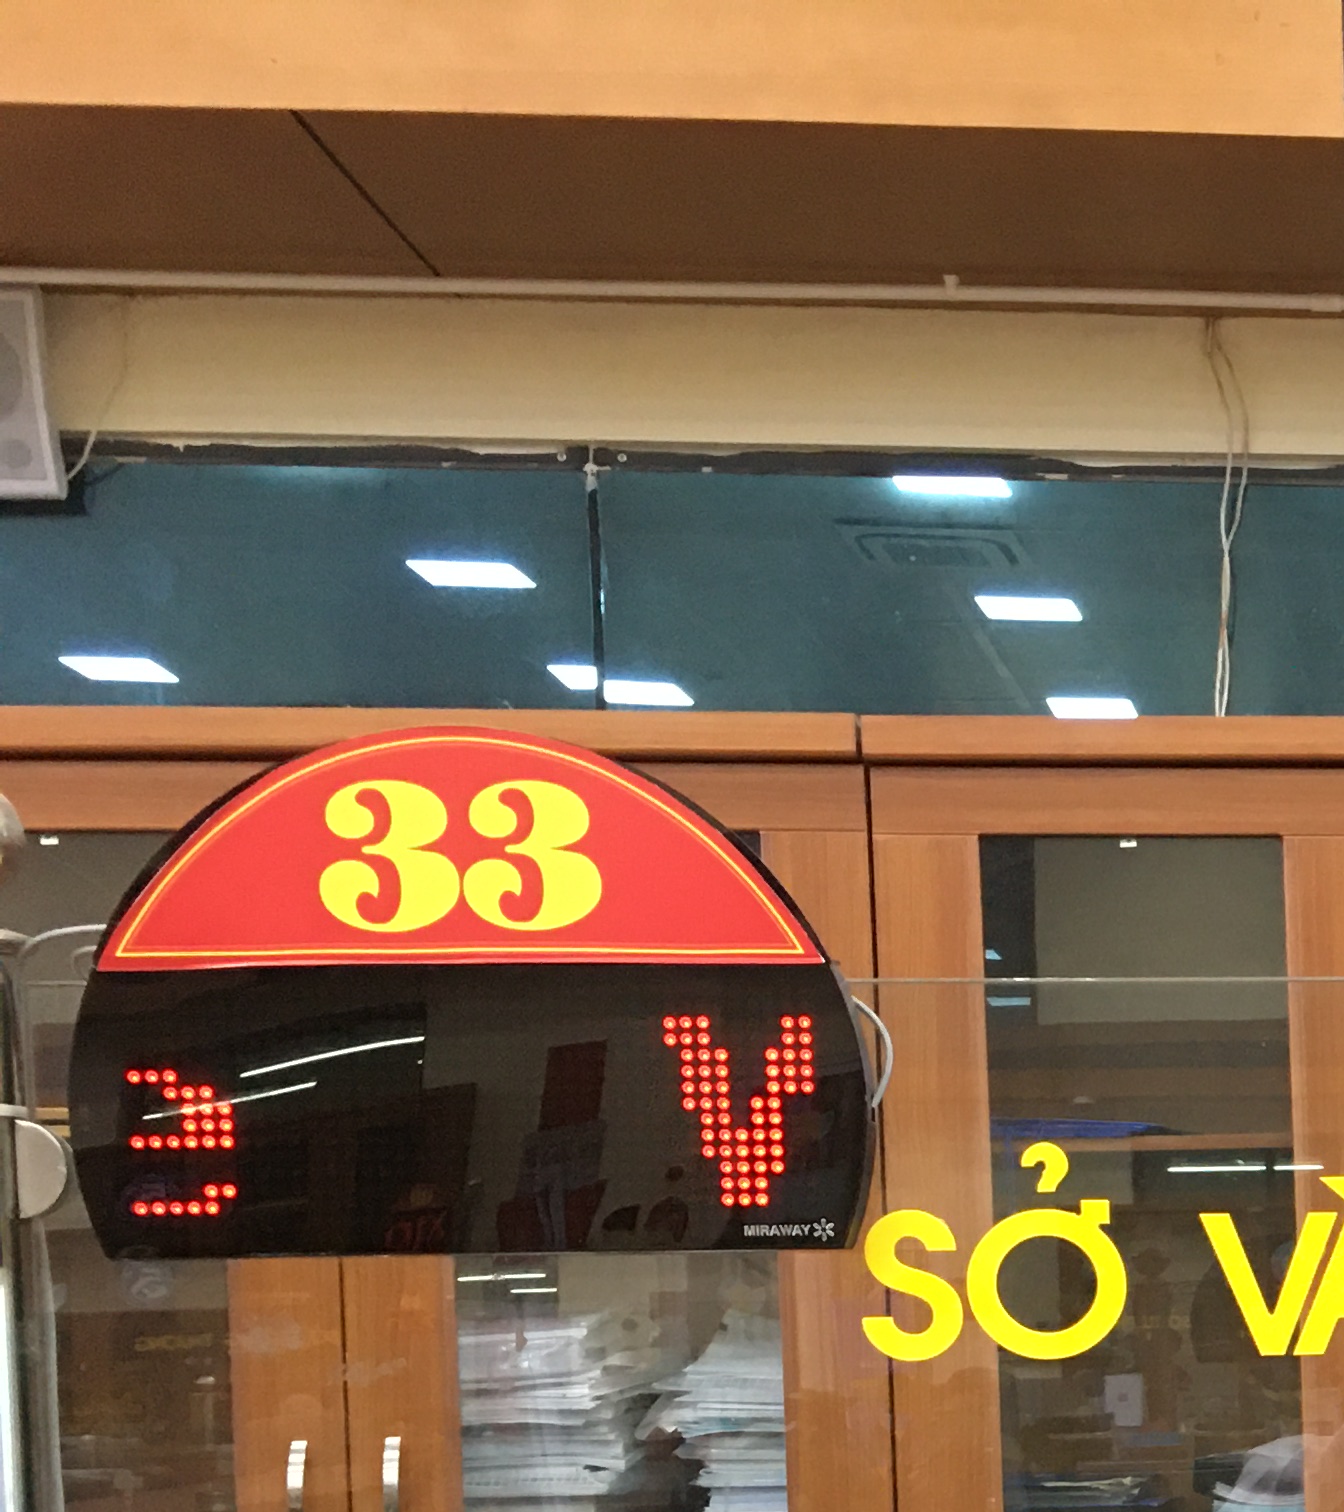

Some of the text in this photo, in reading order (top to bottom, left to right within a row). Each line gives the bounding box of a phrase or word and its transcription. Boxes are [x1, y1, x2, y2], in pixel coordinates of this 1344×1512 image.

[318, 779, 603, 933] 33
[743, 1224, 811, 1238] MIRAWAY
[861, 1140, 1128, 1363] SỞ
